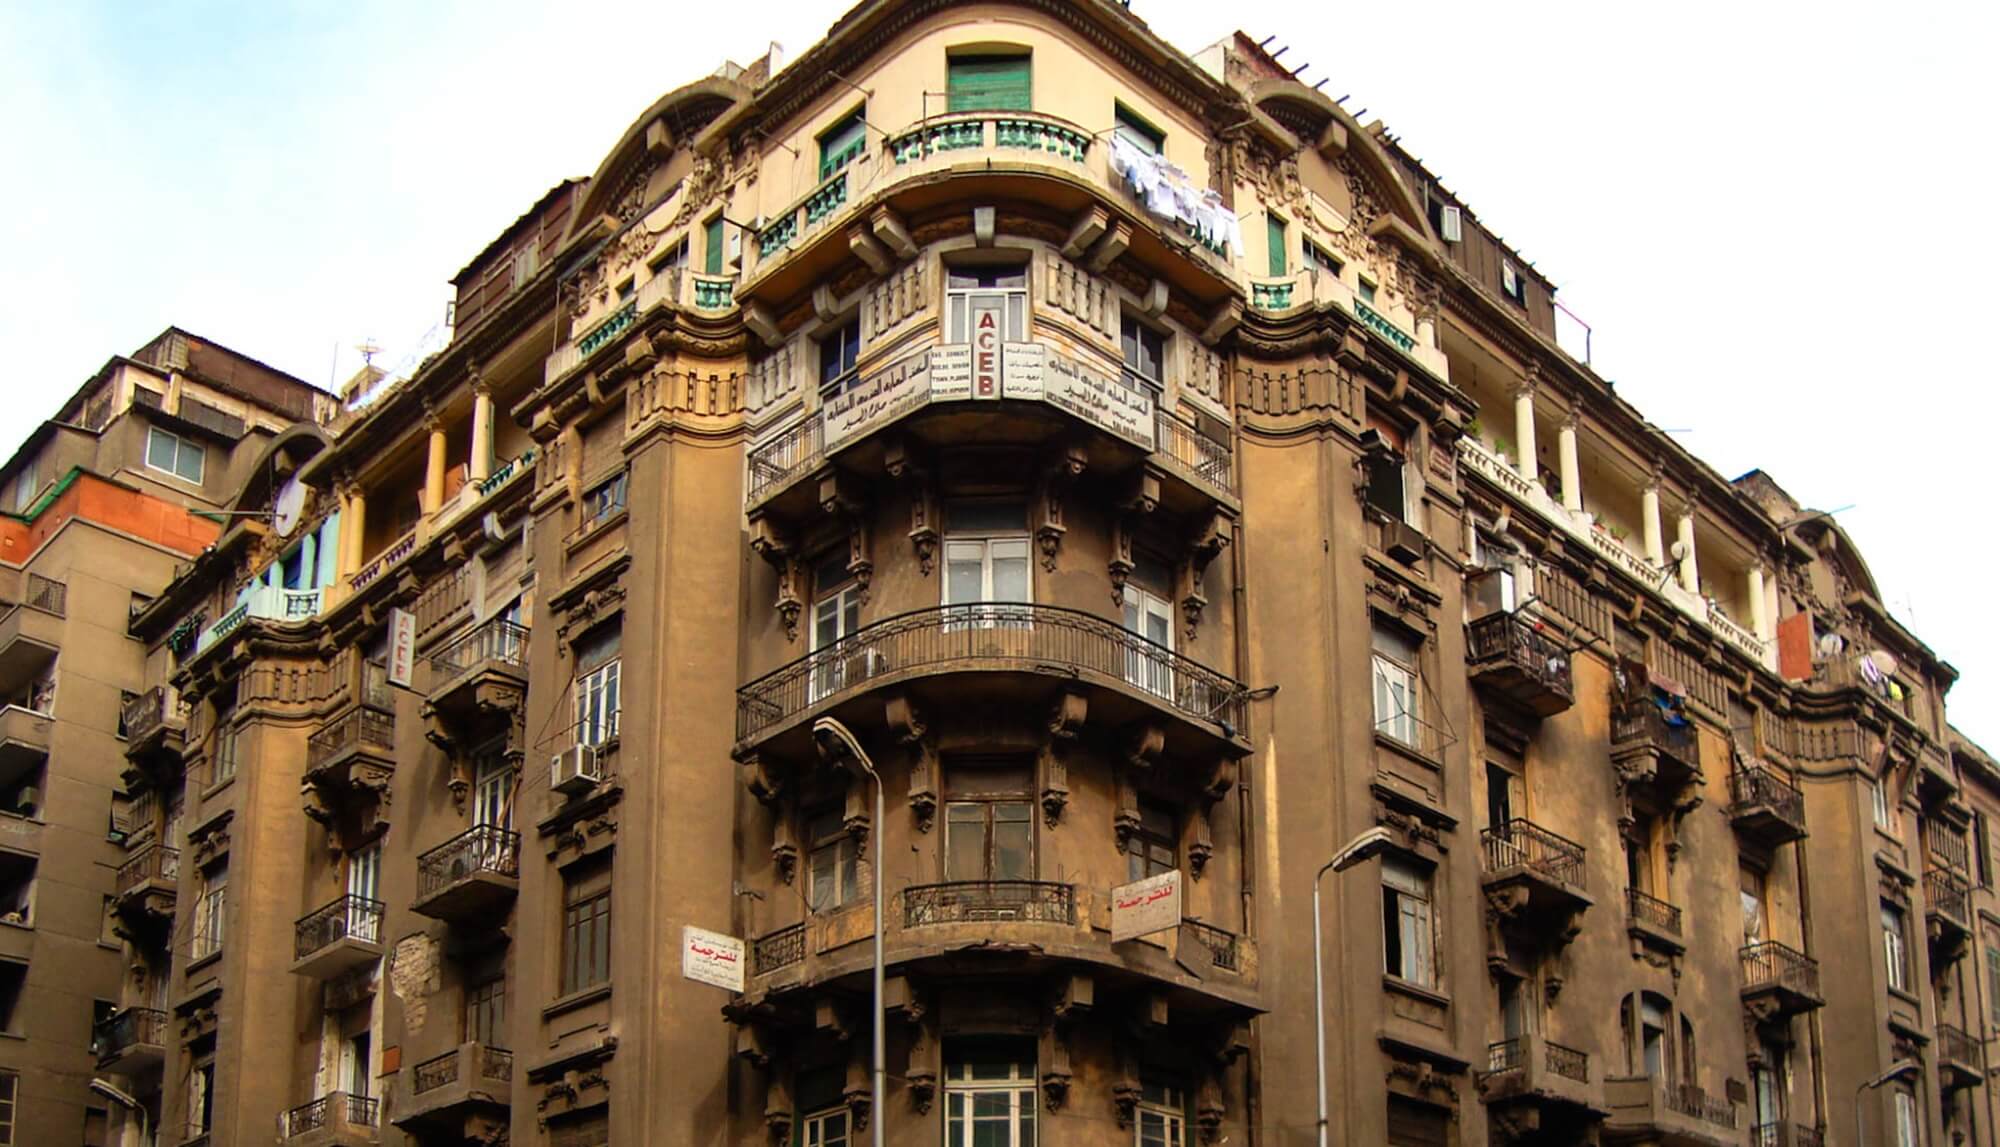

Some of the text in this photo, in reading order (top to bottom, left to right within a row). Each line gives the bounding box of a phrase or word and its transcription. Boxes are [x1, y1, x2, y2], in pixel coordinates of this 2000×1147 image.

[979, 312, 995, 396] ACEB
[1115, 885, 1173, 909] للترجمة
[690, 938, 737, 962] للترجمة
